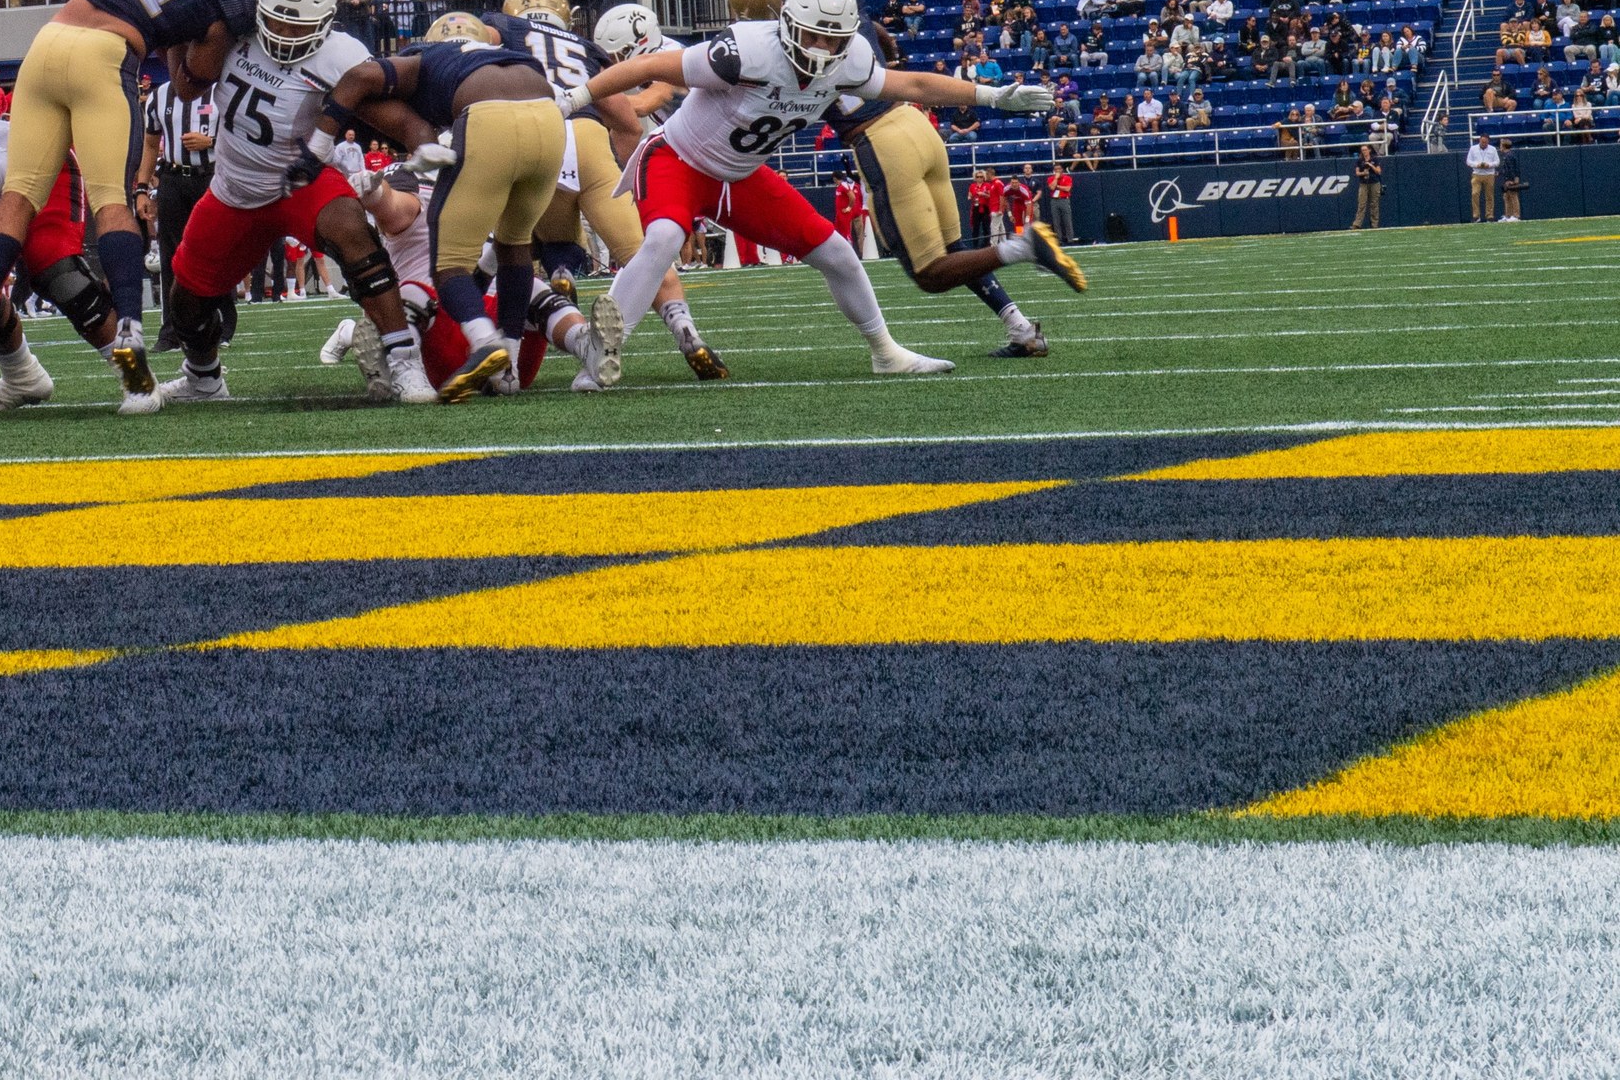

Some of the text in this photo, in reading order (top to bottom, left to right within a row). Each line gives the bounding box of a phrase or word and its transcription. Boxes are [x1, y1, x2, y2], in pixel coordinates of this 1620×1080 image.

[527, 12, 549, 21] NAVY
[236, 58, 284, 88] CINCINNATI
[525, 31, 590, 87] 15
[224, 72, 276, 148] 75
[768, 100, 820, 114] CINCINNATI
[729, 115, 808, 156] 82
[1196, 175, 1350, 201] BOEING
